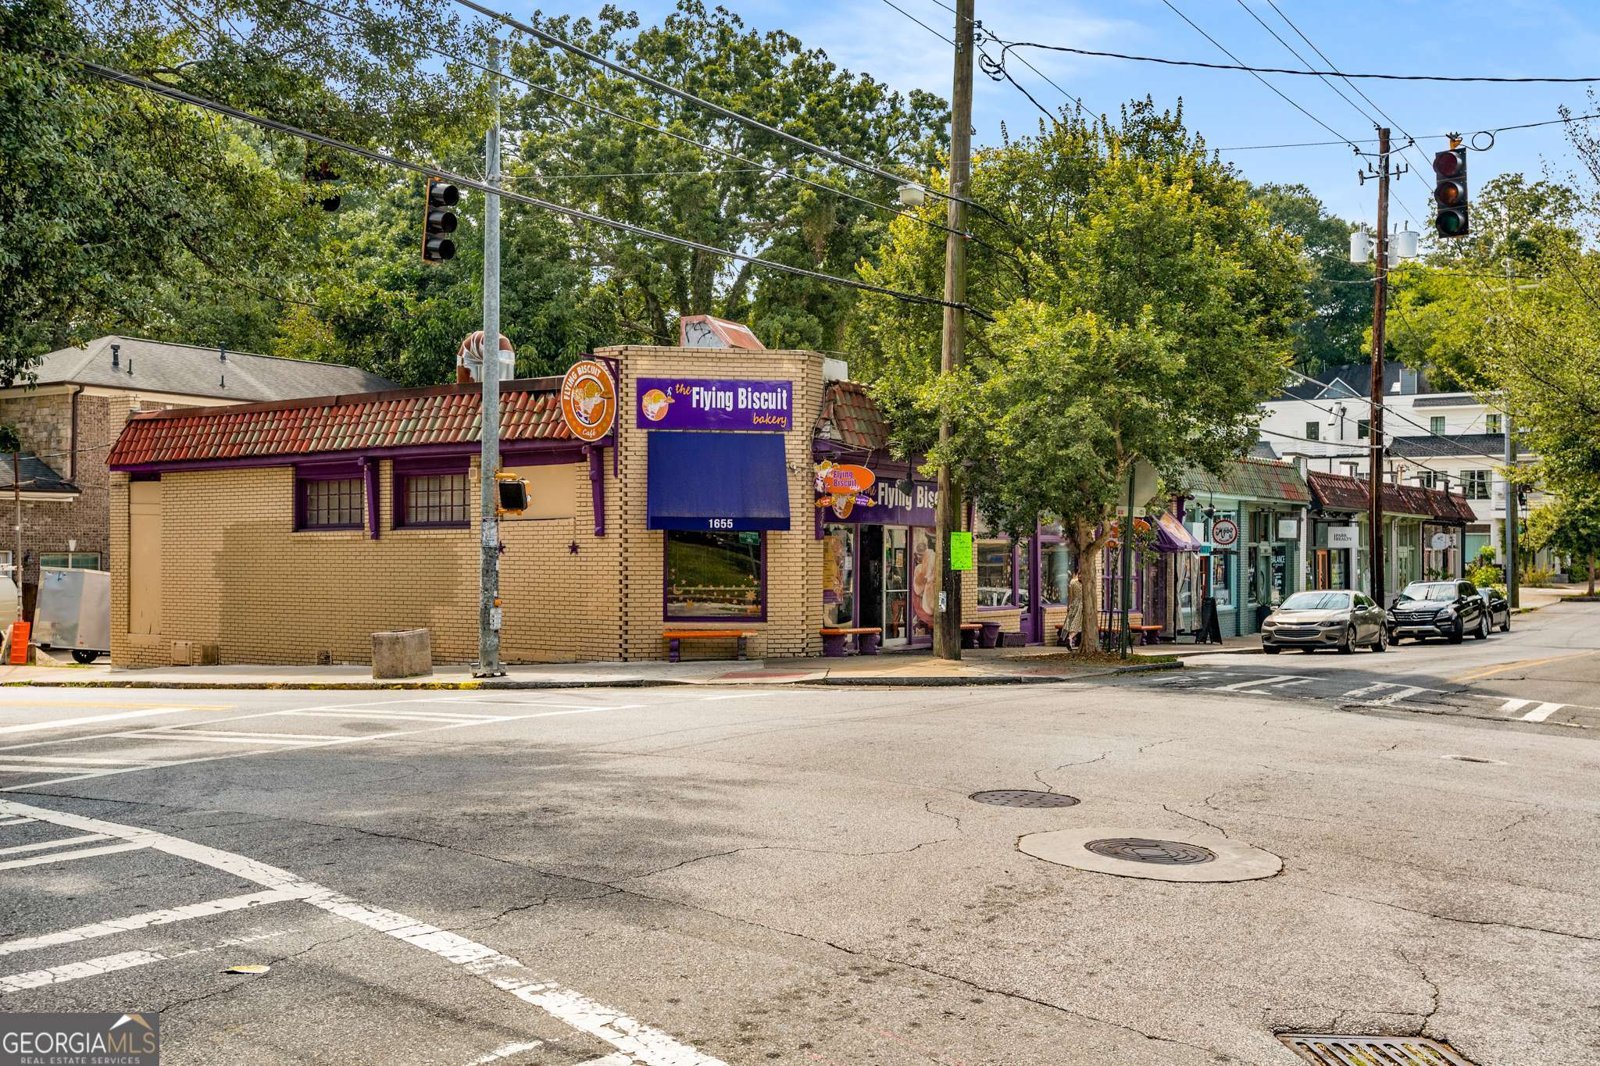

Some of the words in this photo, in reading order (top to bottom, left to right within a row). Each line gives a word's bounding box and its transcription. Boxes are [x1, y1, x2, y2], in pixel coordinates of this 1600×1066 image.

[563, 370, 578, 401] FLYING
[576, 364, 602, 378] BISCUIT
[675, 383, 692, 396] the
[691, 386, 734, 412] Flying
[737, 387, 788, 410] Biscuit
[752, 412, 788, 428] bakery
[833, 470, 853, 479] Flying
[833, 479, 857, 487] Biscuit
[708, 518, 734, 529] 1655
